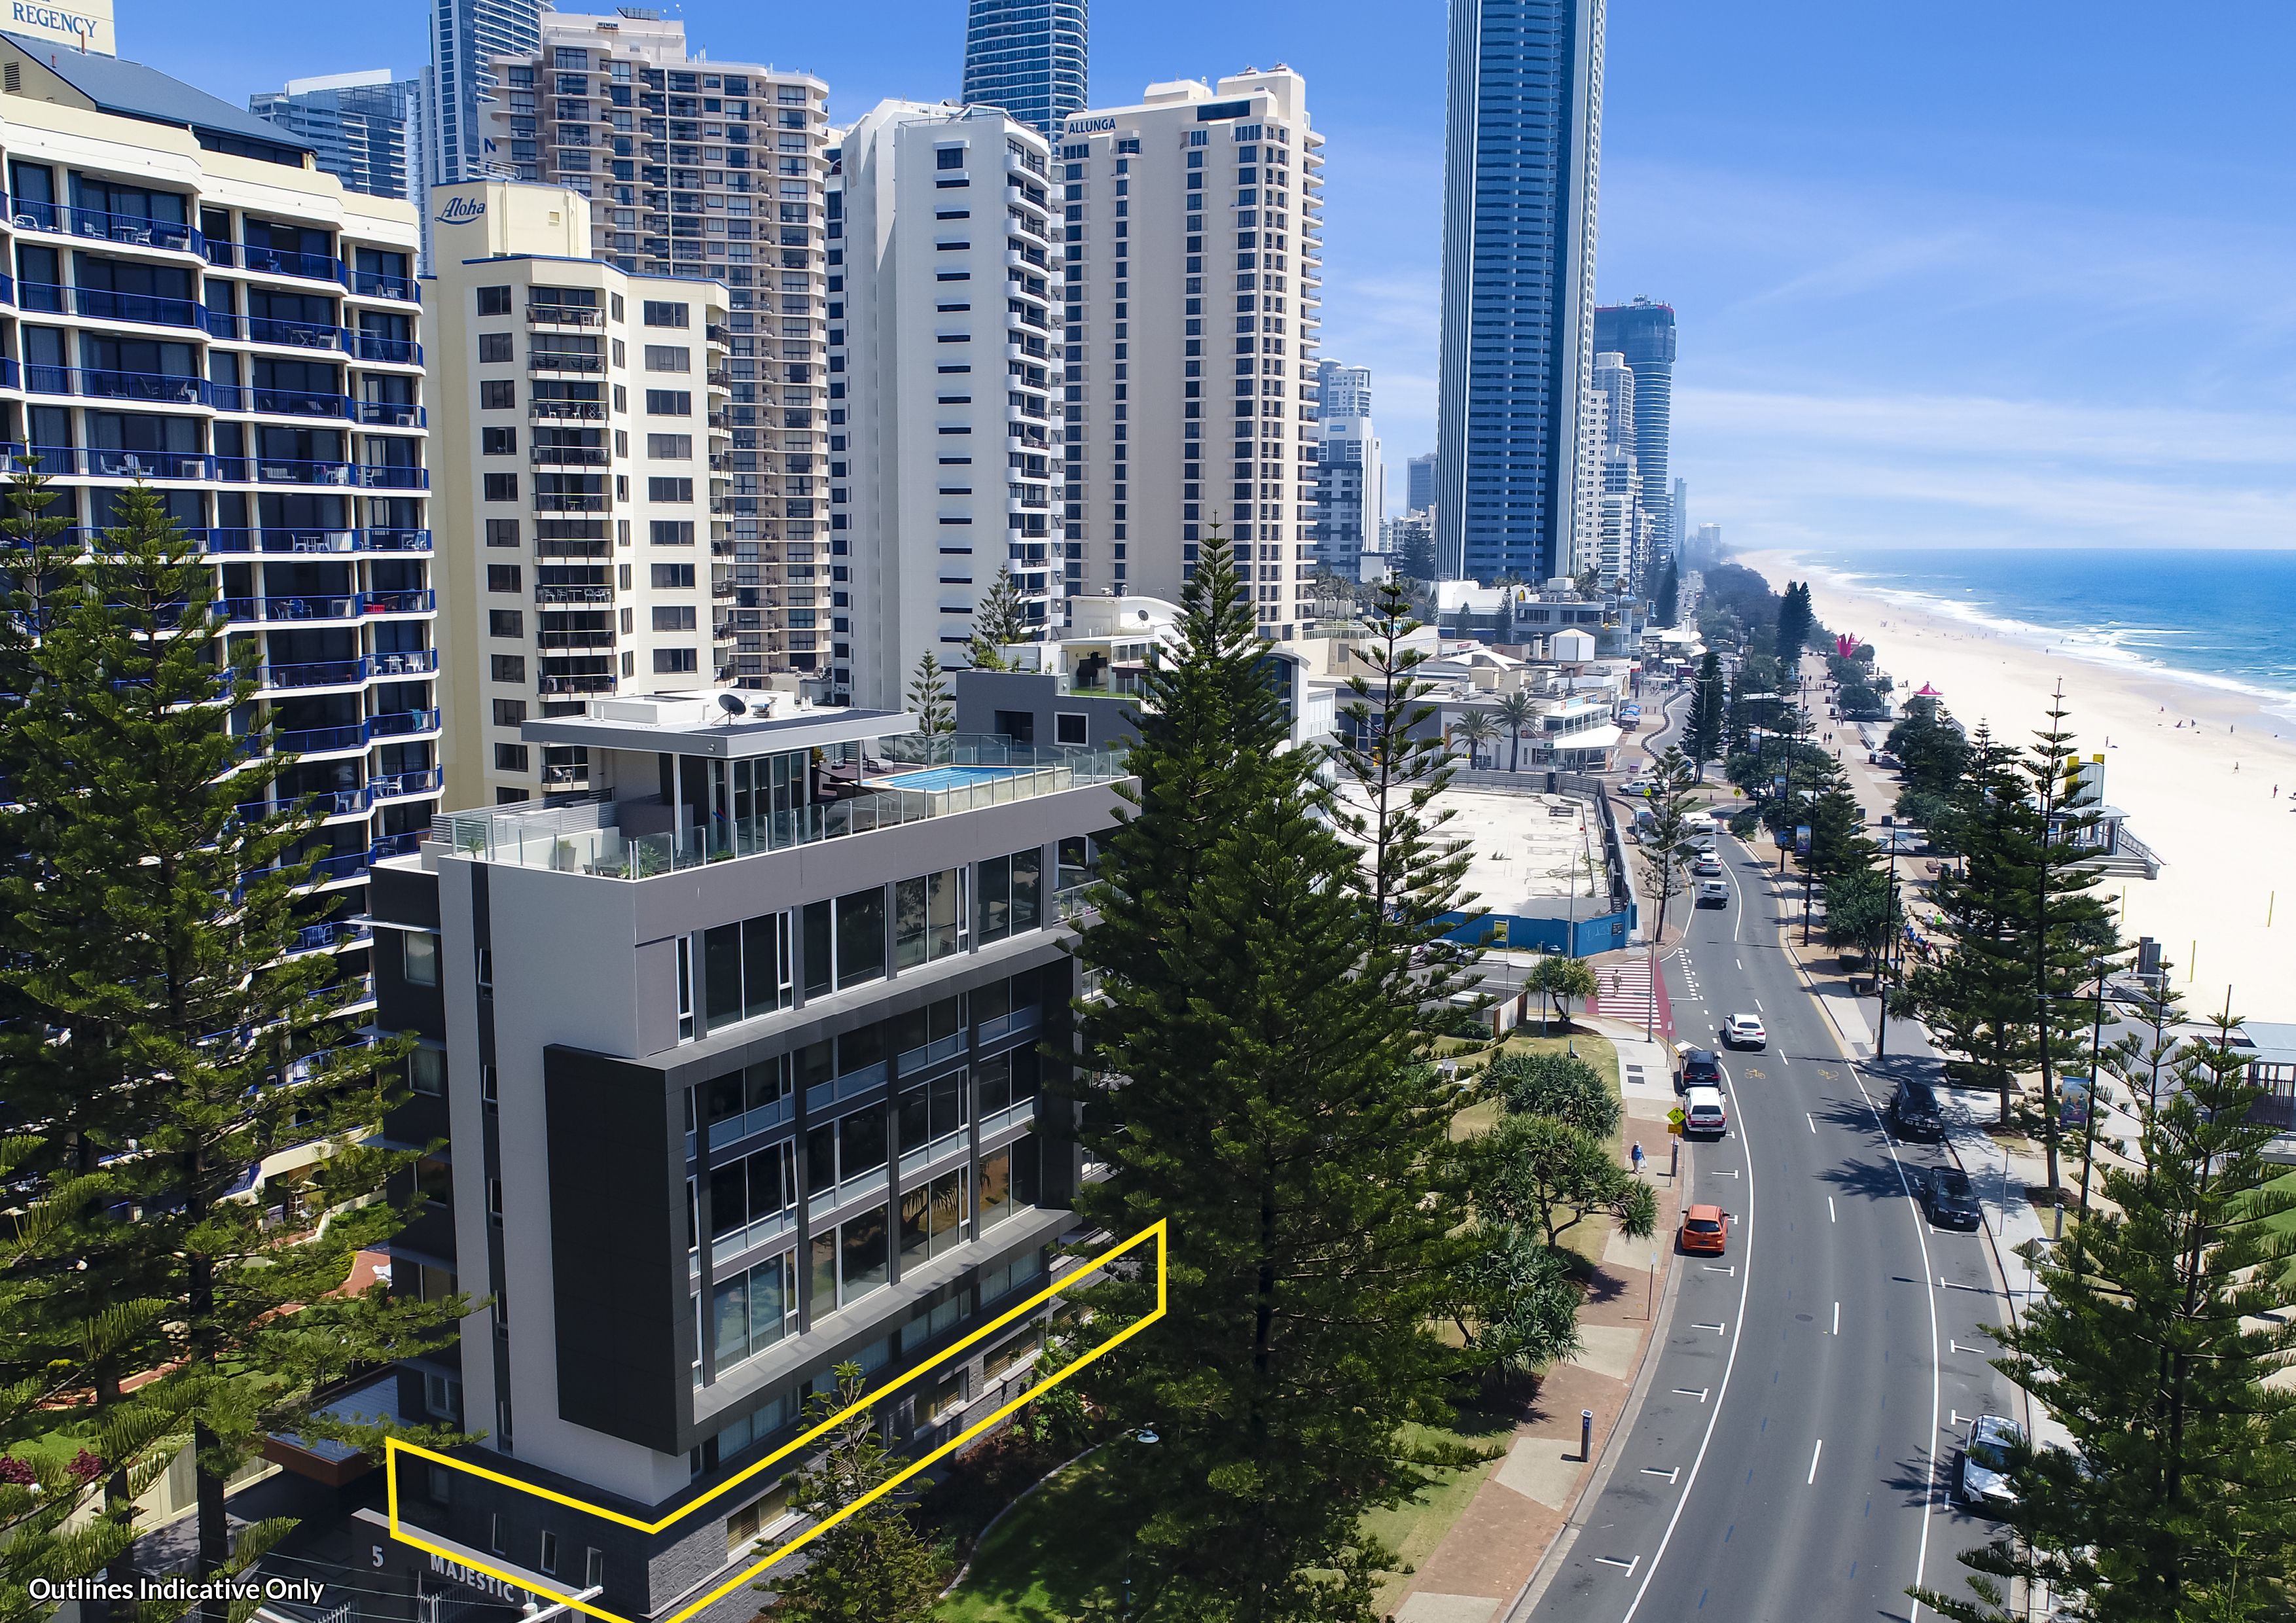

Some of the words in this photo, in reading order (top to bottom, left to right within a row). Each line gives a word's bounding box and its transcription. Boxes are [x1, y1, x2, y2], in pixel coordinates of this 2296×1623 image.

[12, 1, 97, 38] REGENCY
[1068, 118, 1116, 134] ALLUNGA
[436, 197, 486, 223] Aloha
[372, 1545, 384, 1567] 5
[430, 1553, 514, 1602] MAJESTIC
